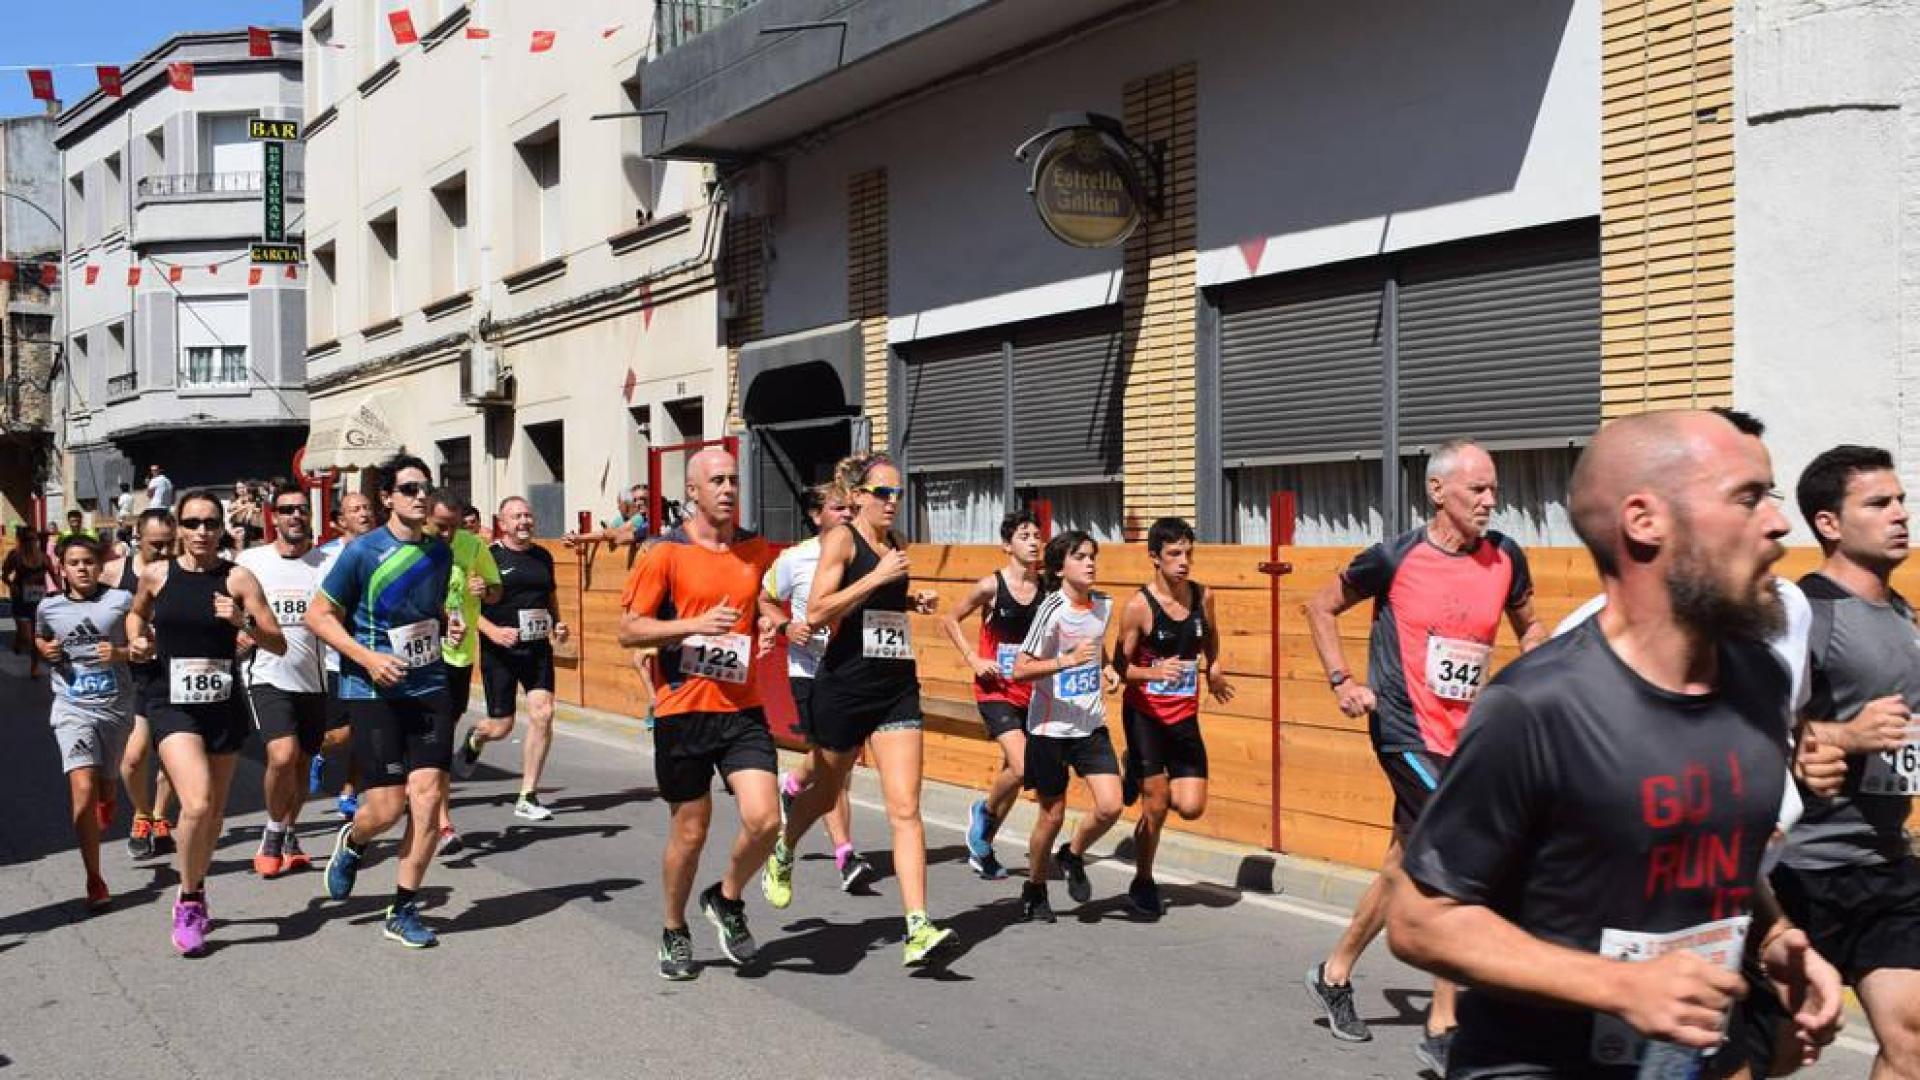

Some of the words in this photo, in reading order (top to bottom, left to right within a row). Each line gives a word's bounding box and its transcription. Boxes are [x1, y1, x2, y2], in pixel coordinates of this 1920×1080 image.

[252, 122, 297, 138] BAR
[268, 145, 281, 240] RESTAURANTE
[272, 600, 308, 614] 188
[403, 635, 432, 658] 187
[873, 627, 905, 646] 121
[695, 645, 738, 669] 122
[182, 674, 222, 691] 186
[1438, 660, 1482, 686] 342
[1890, 744, 1920, 775] 16
[1641, 761, 1714, 829] GO
[1643, 830, 1744, 901] RUN
